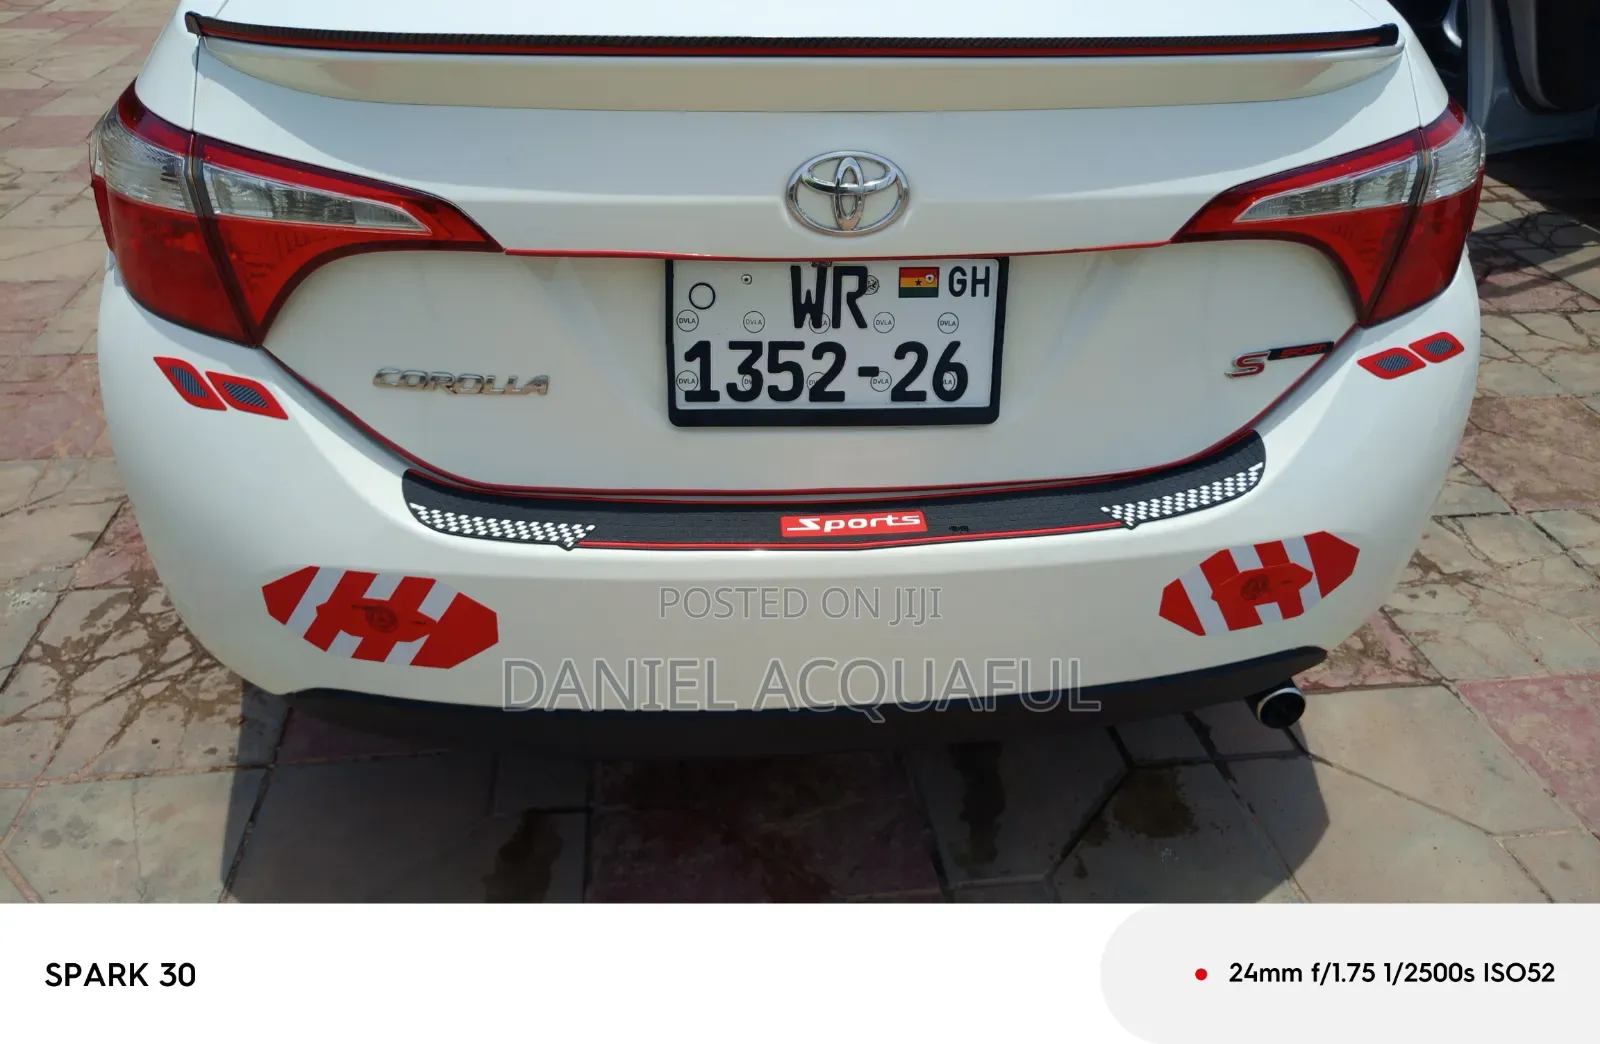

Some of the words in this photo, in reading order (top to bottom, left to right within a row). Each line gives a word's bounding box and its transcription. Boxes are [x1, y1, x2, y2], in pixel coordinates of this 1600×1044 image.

[948, 265, 990, 297] GH
[790, 265, 868, 329] WR
[678, 317, 697, 325] DVLA
[372, 367, 550, 396] COROLLA
[684, 340, 968, 402] 1352-26
[786, 514, 921, 532] Sports
